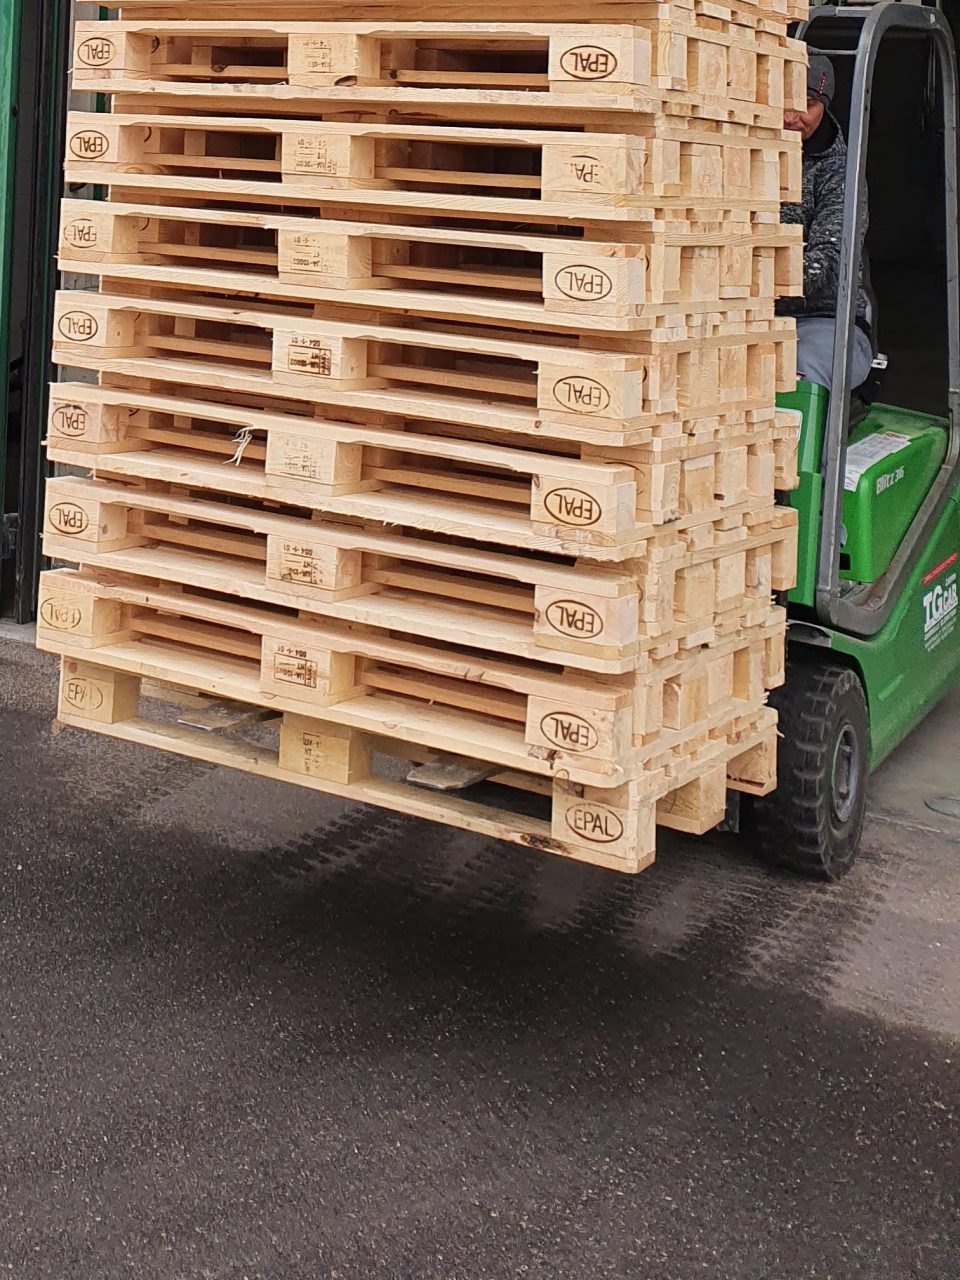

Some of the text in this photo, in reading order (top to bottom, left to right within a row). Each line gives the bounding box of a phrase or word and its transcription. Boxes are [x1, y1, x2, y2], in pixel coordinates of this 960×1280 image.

[84, 43, 111, 60] EPAL
[569, 52, 609, 73] EPAL
[76, 136, 103, 153] EPAL
[564, 270, 604, 295] EPAL
[65, 317, 92, 336] EPAL
[562, 382, 602, 408] EPAL
[59, 411, 86, 431] EPAL
[55, 508, 83, 529] EPAL
[553, 493, 593, 521] EPAL
[554, 605, 595, 634] EPAL
[550, 716, 590, 747] EPAL
[574, 808, 615, 838] EPAL
